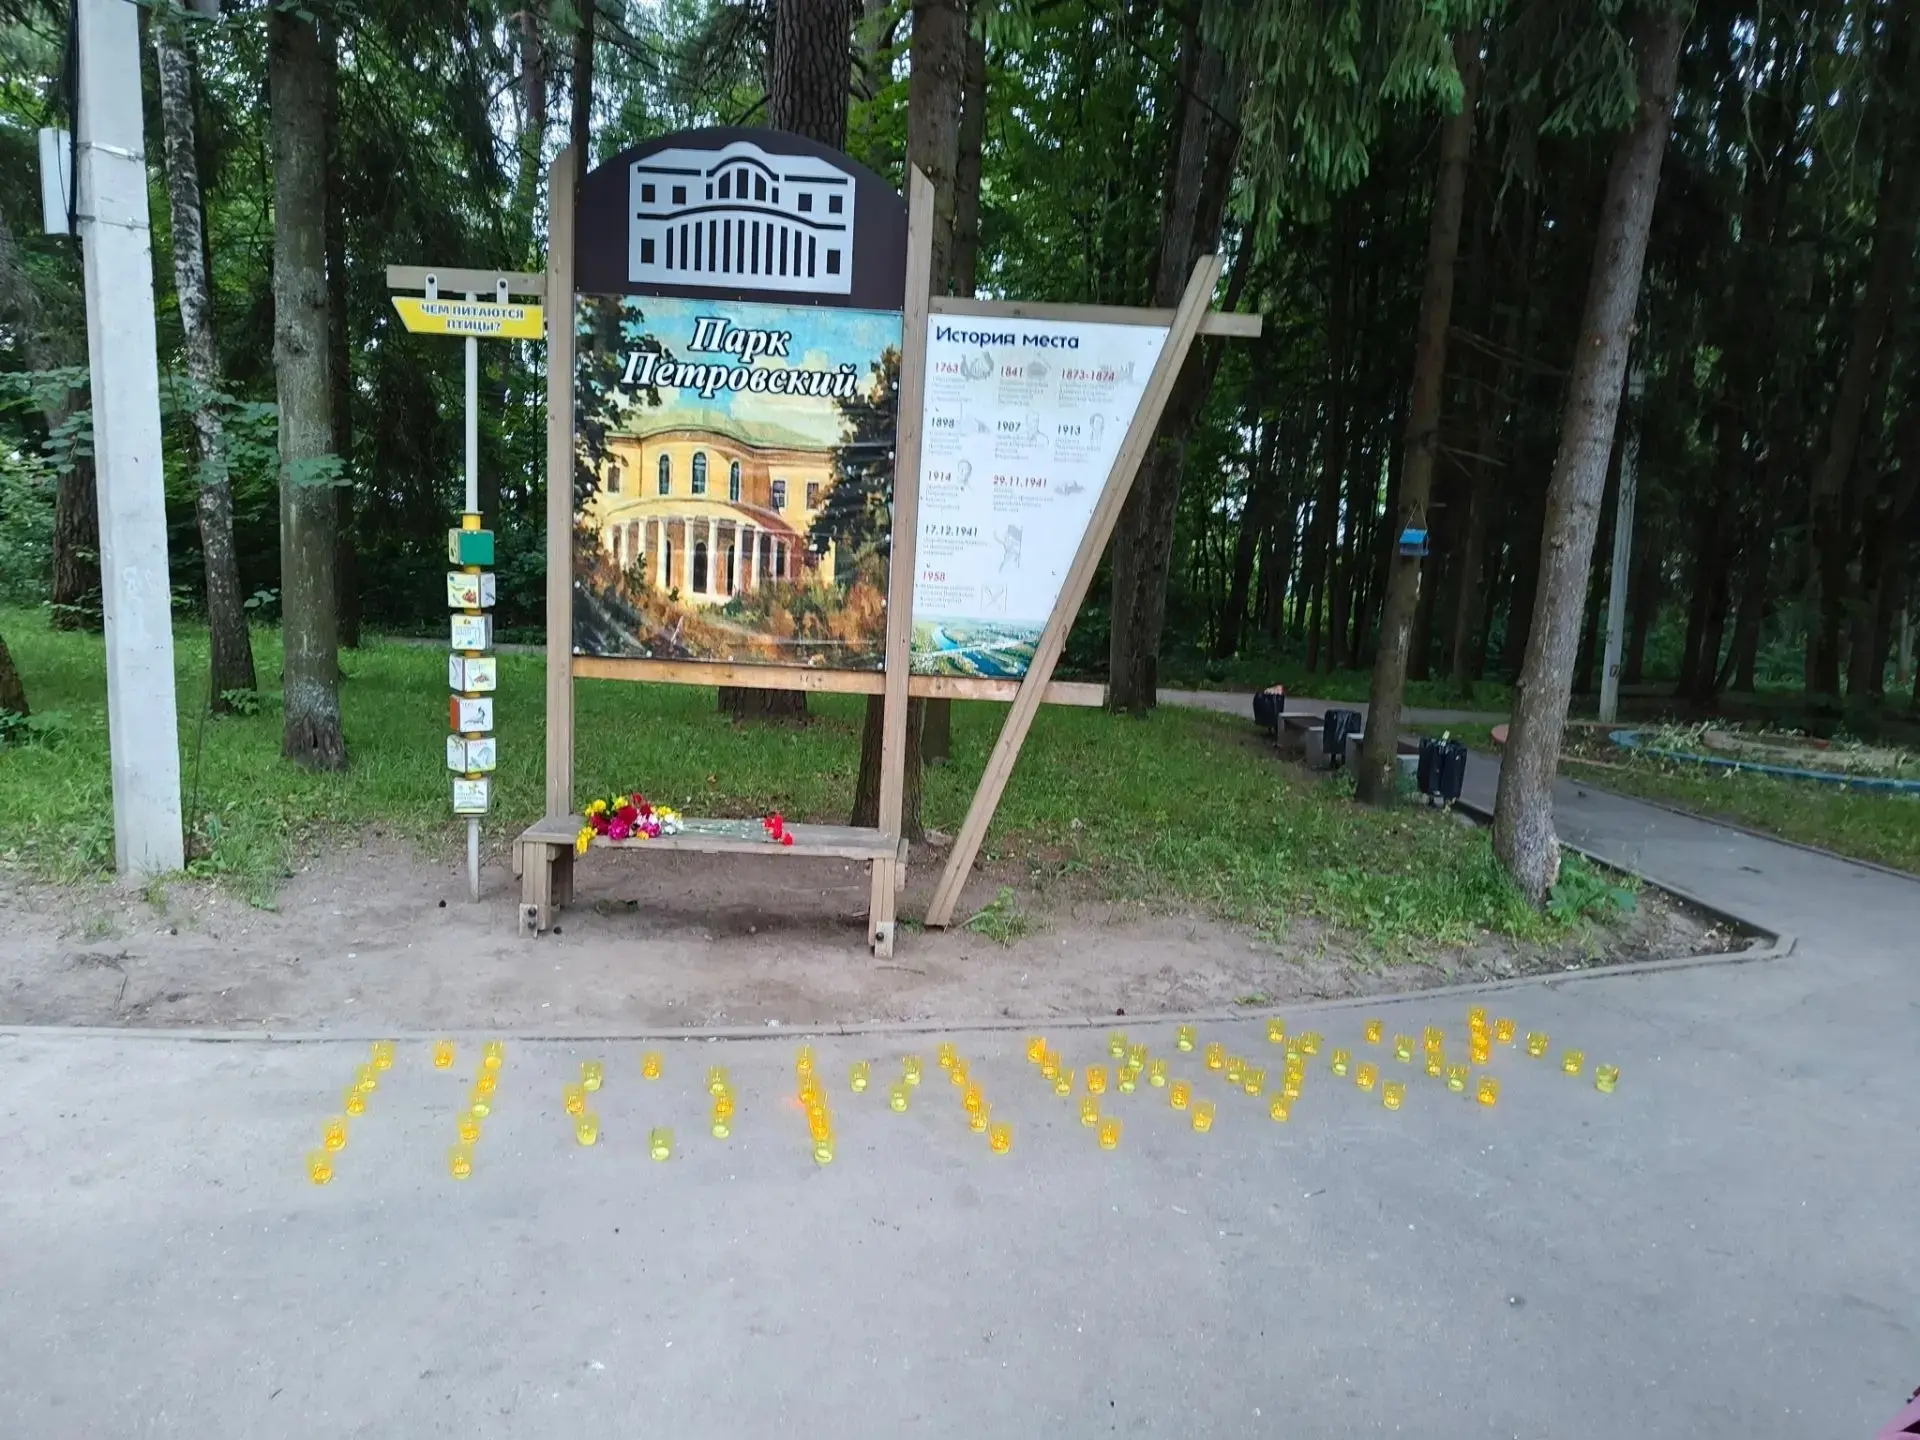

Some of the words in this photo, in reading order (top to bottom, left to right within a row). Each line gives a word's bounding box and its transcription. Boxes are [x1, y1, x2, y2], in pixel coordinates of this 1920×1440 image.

[422, 303, 449, 315] ЧЕМ
[453, 305, 524, 320] ПИТАЮТСЯ
[447, 319, 500, 333] ПТИЦЫ?
[687, 316, 791, 363] Парк
[936, 326, 1016, 348] История
[1022, 332, 1080, 350] места
[935, 361, 958, 374] 1763
[1000, 365, 1023, 378] 1841
[620, 351, 858, 399] Петровский
[930, 416, 955, 429] 1898
[996, 420, 1021, 433] 1907
[1057, 424, 1081, 436] 1913
[928, 470, 952, 482] 1914
[992, 473, 1048, 489] 29.11.1941
[925, 524, 978, 538] 17.12.1941
[922, 570, 946, 582] 1958
